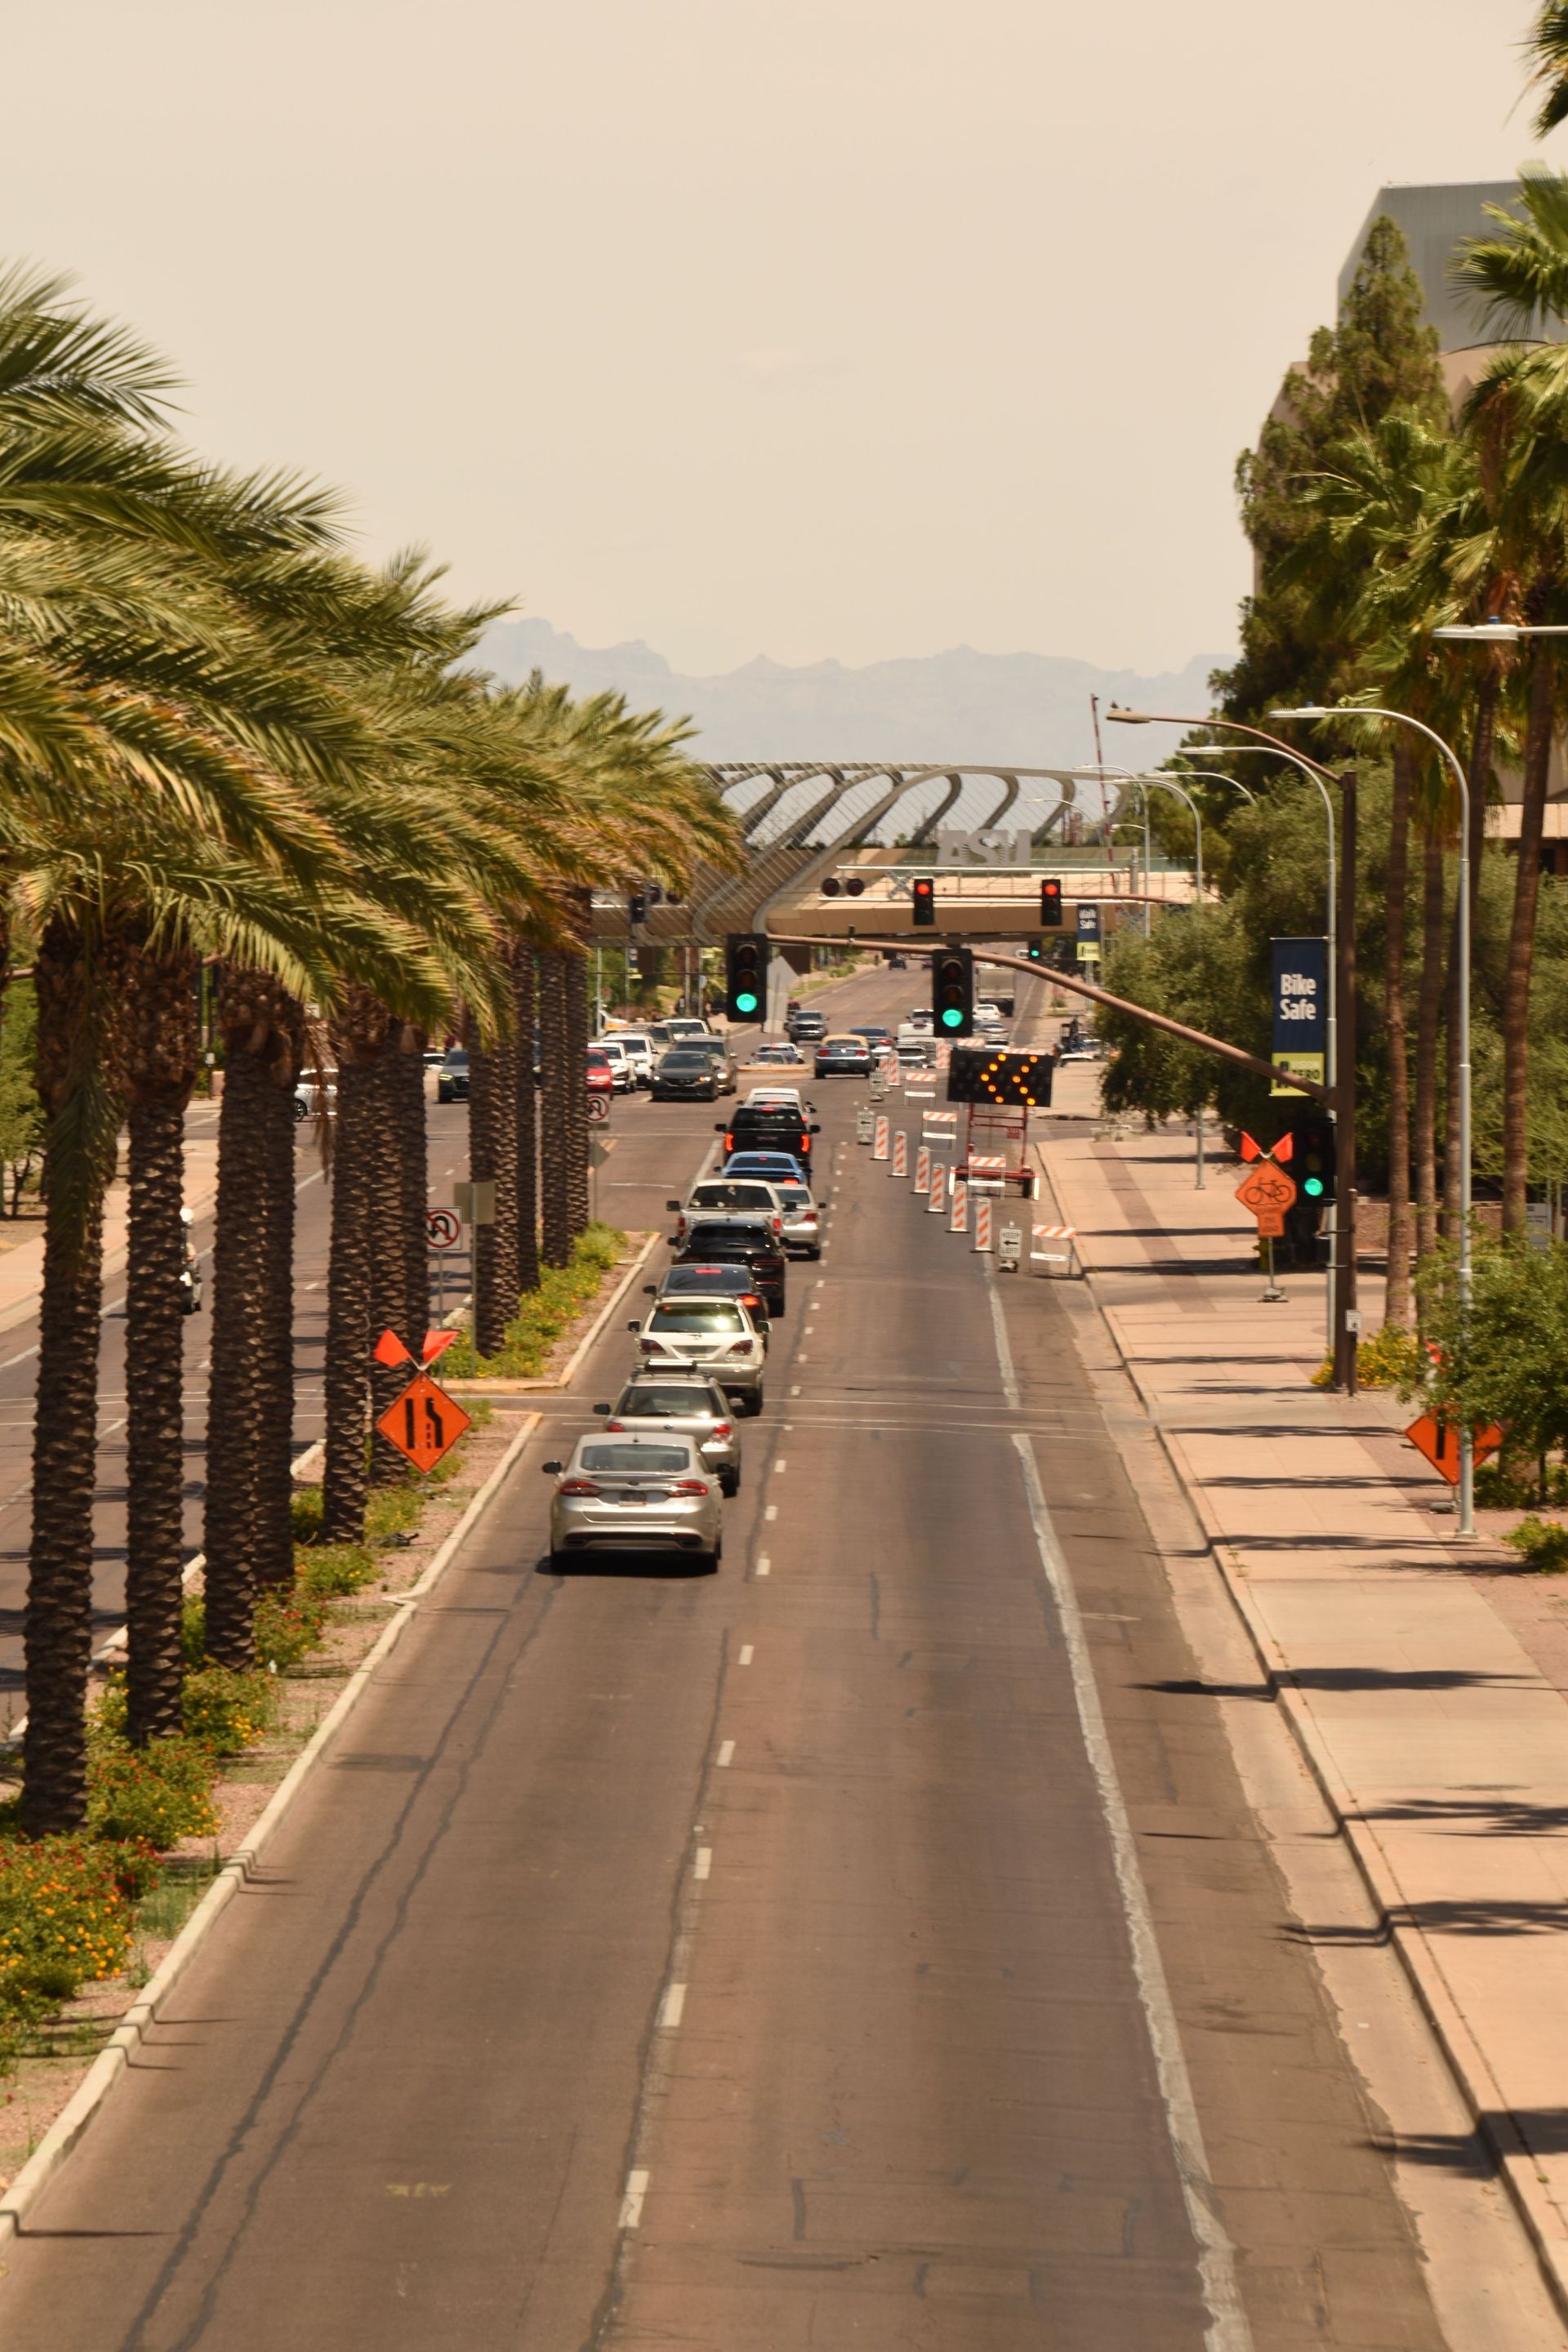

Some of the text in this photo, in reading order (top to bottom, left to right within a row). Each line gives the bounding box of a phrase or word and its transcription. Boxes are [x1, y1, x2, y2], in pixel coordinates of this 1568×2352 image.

[937, 829, 1031, 866] ASU
[1280, 973, 1316, 996] Bike
[1279, 999, 1316, 1020] Safe
